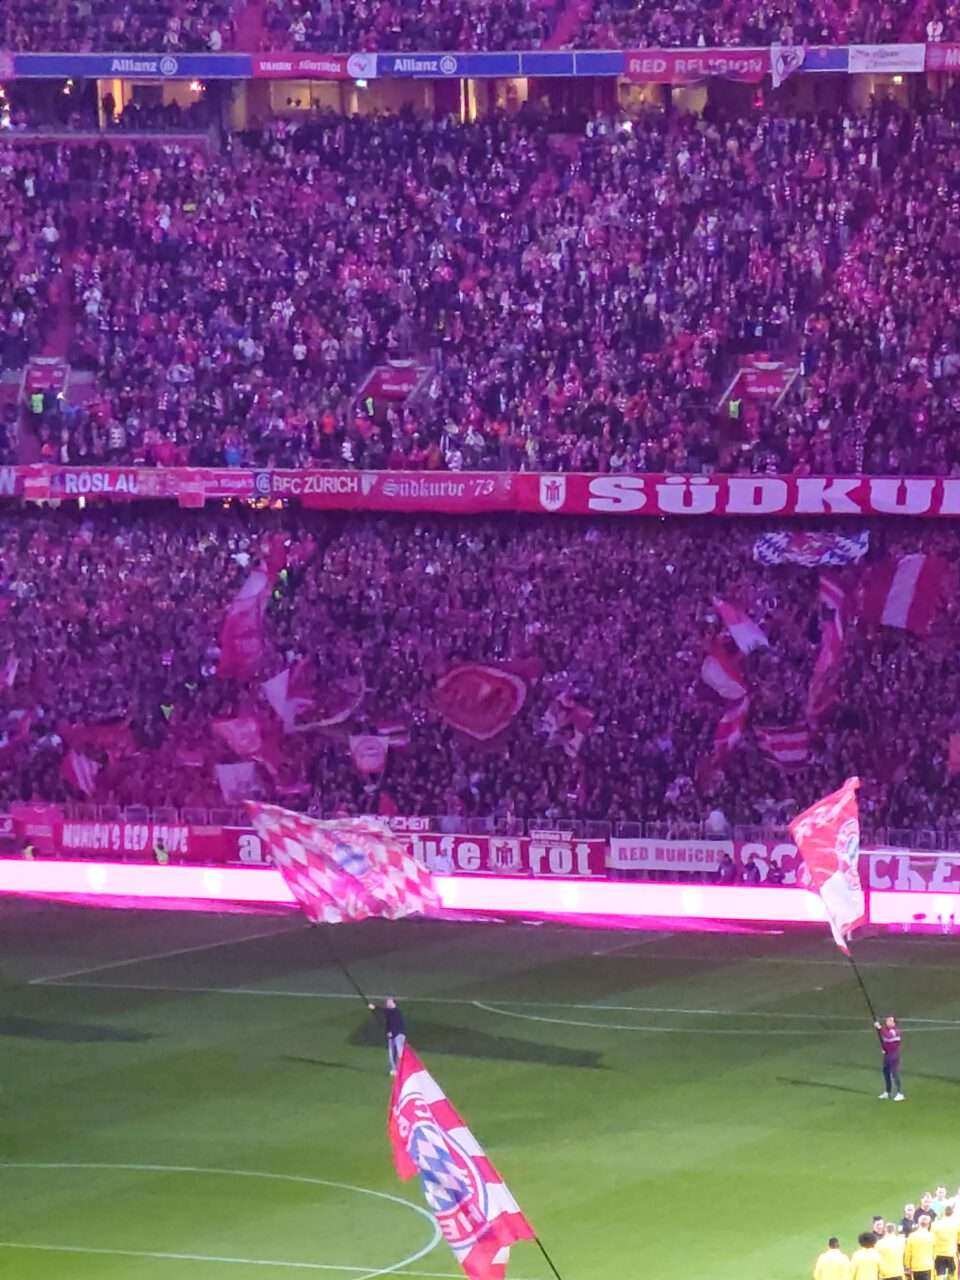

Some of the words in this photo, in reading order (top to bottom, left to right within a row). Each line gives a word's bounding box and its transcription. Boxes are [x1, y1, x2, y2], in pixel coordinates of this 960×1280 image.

[111, 58, 157, 73] Allianz
[393, 57, 438, 73] Allianz
[629, 58, 667, 73] RED
[303, 473, 358, 494] ZÜRICH
[382, 477, 465, 498] Südkurve
[529, 842, 593, 875] rot
[618, 847, 649, 862] RED
